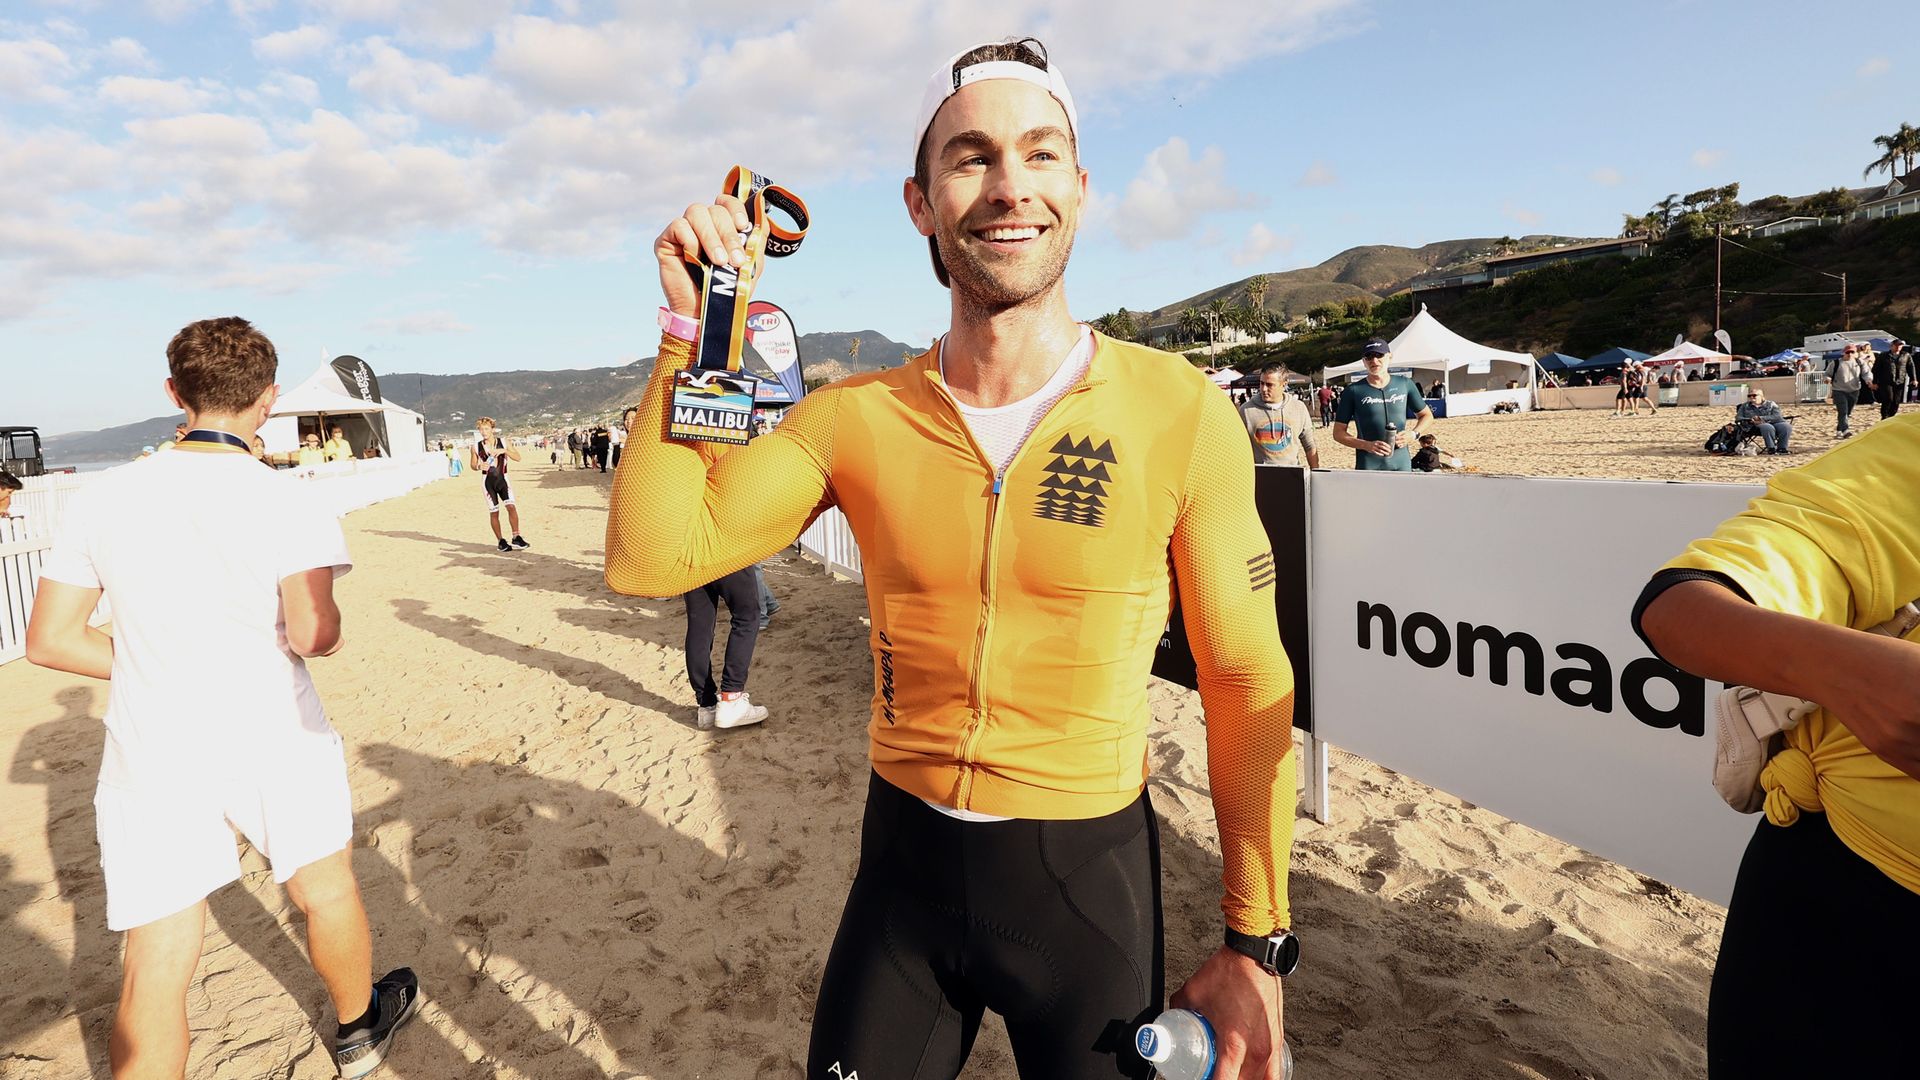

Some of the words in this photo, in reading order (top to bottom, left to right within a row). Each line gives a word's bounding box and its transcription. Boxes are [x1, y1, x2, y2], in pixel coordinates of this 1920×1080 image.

[767, 239, 800, 253] 2023
[352, 369, 373, 402] rager
[674, 406, 749, 430] MALIBU
[717, 437, 746, 445] DISTANCE
[1357, 600, 1706, 737] nomad
